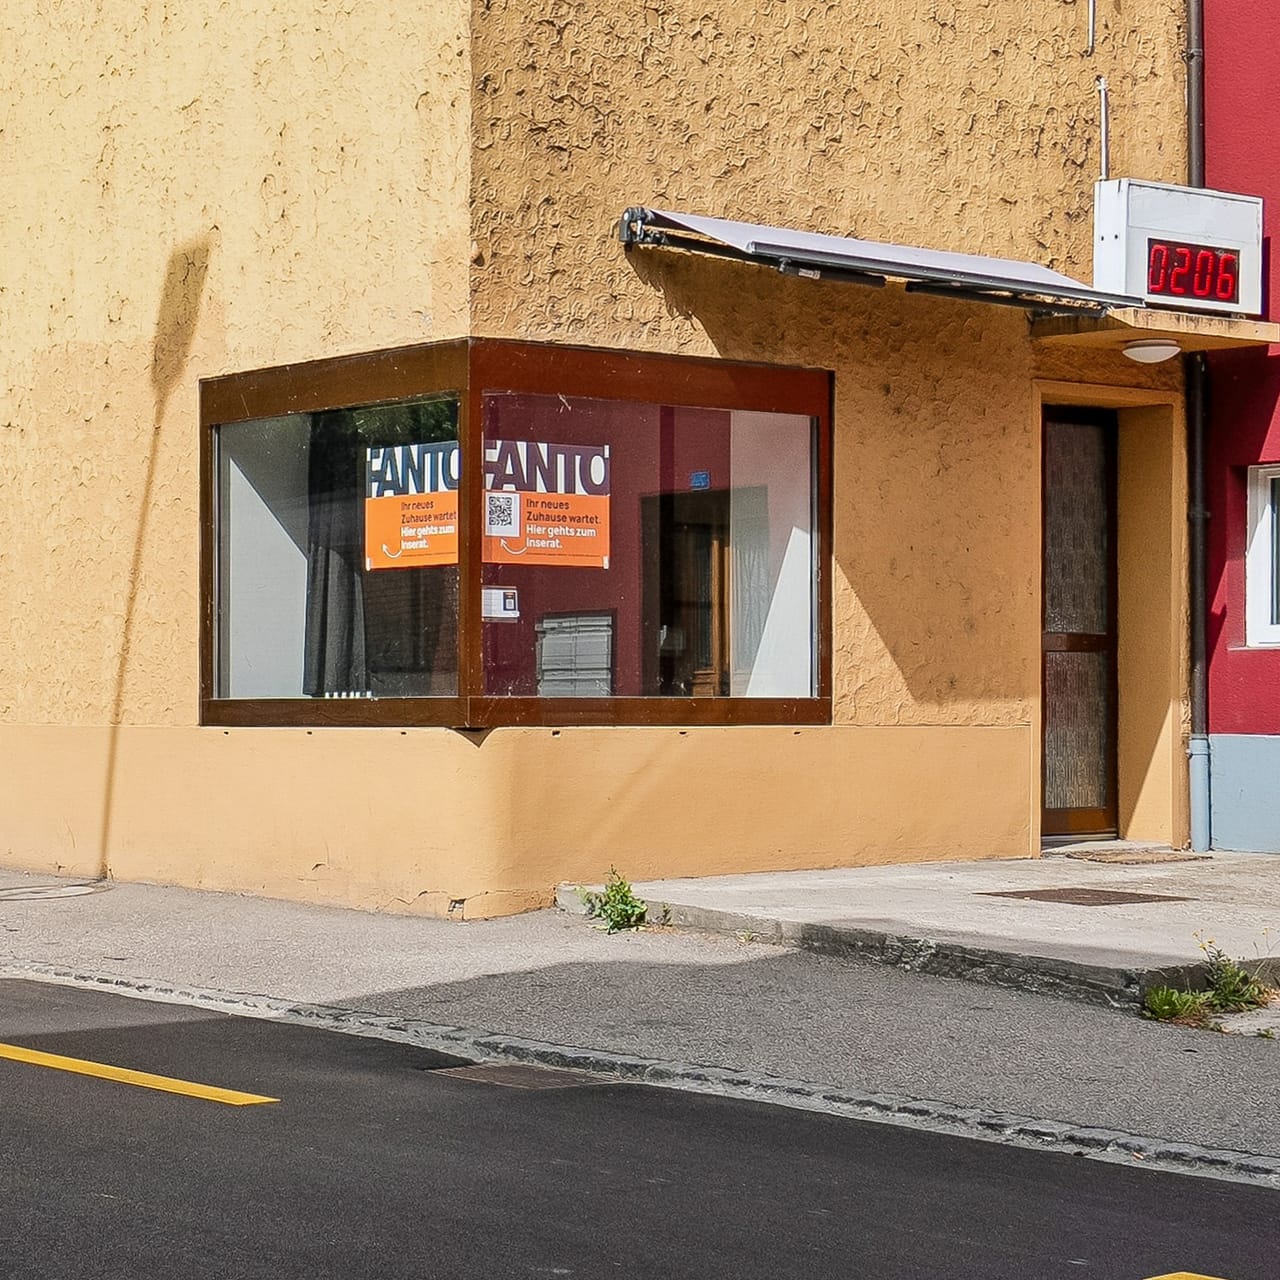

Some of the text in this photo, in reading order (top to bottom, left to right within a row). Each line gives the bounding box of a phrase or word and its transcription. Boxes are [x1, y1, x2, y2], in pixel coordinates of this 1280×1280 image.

[1149, 244, 1237, 299] 0206
[401, 501, 434, 511] Ihr neues
[526, 498, 570, 510] Ihr neues
[401, 513, 432, 524] Zuhause
[526, 511, 601, 525] Zuhause wartet.
[401, 525, 455, 538] Hier gehts zum
[526, 524, 596, 538] Hier gehts zum
[401, 539, 429, 550] Inserat.
[526, 537, 563, 549] Inserat.
